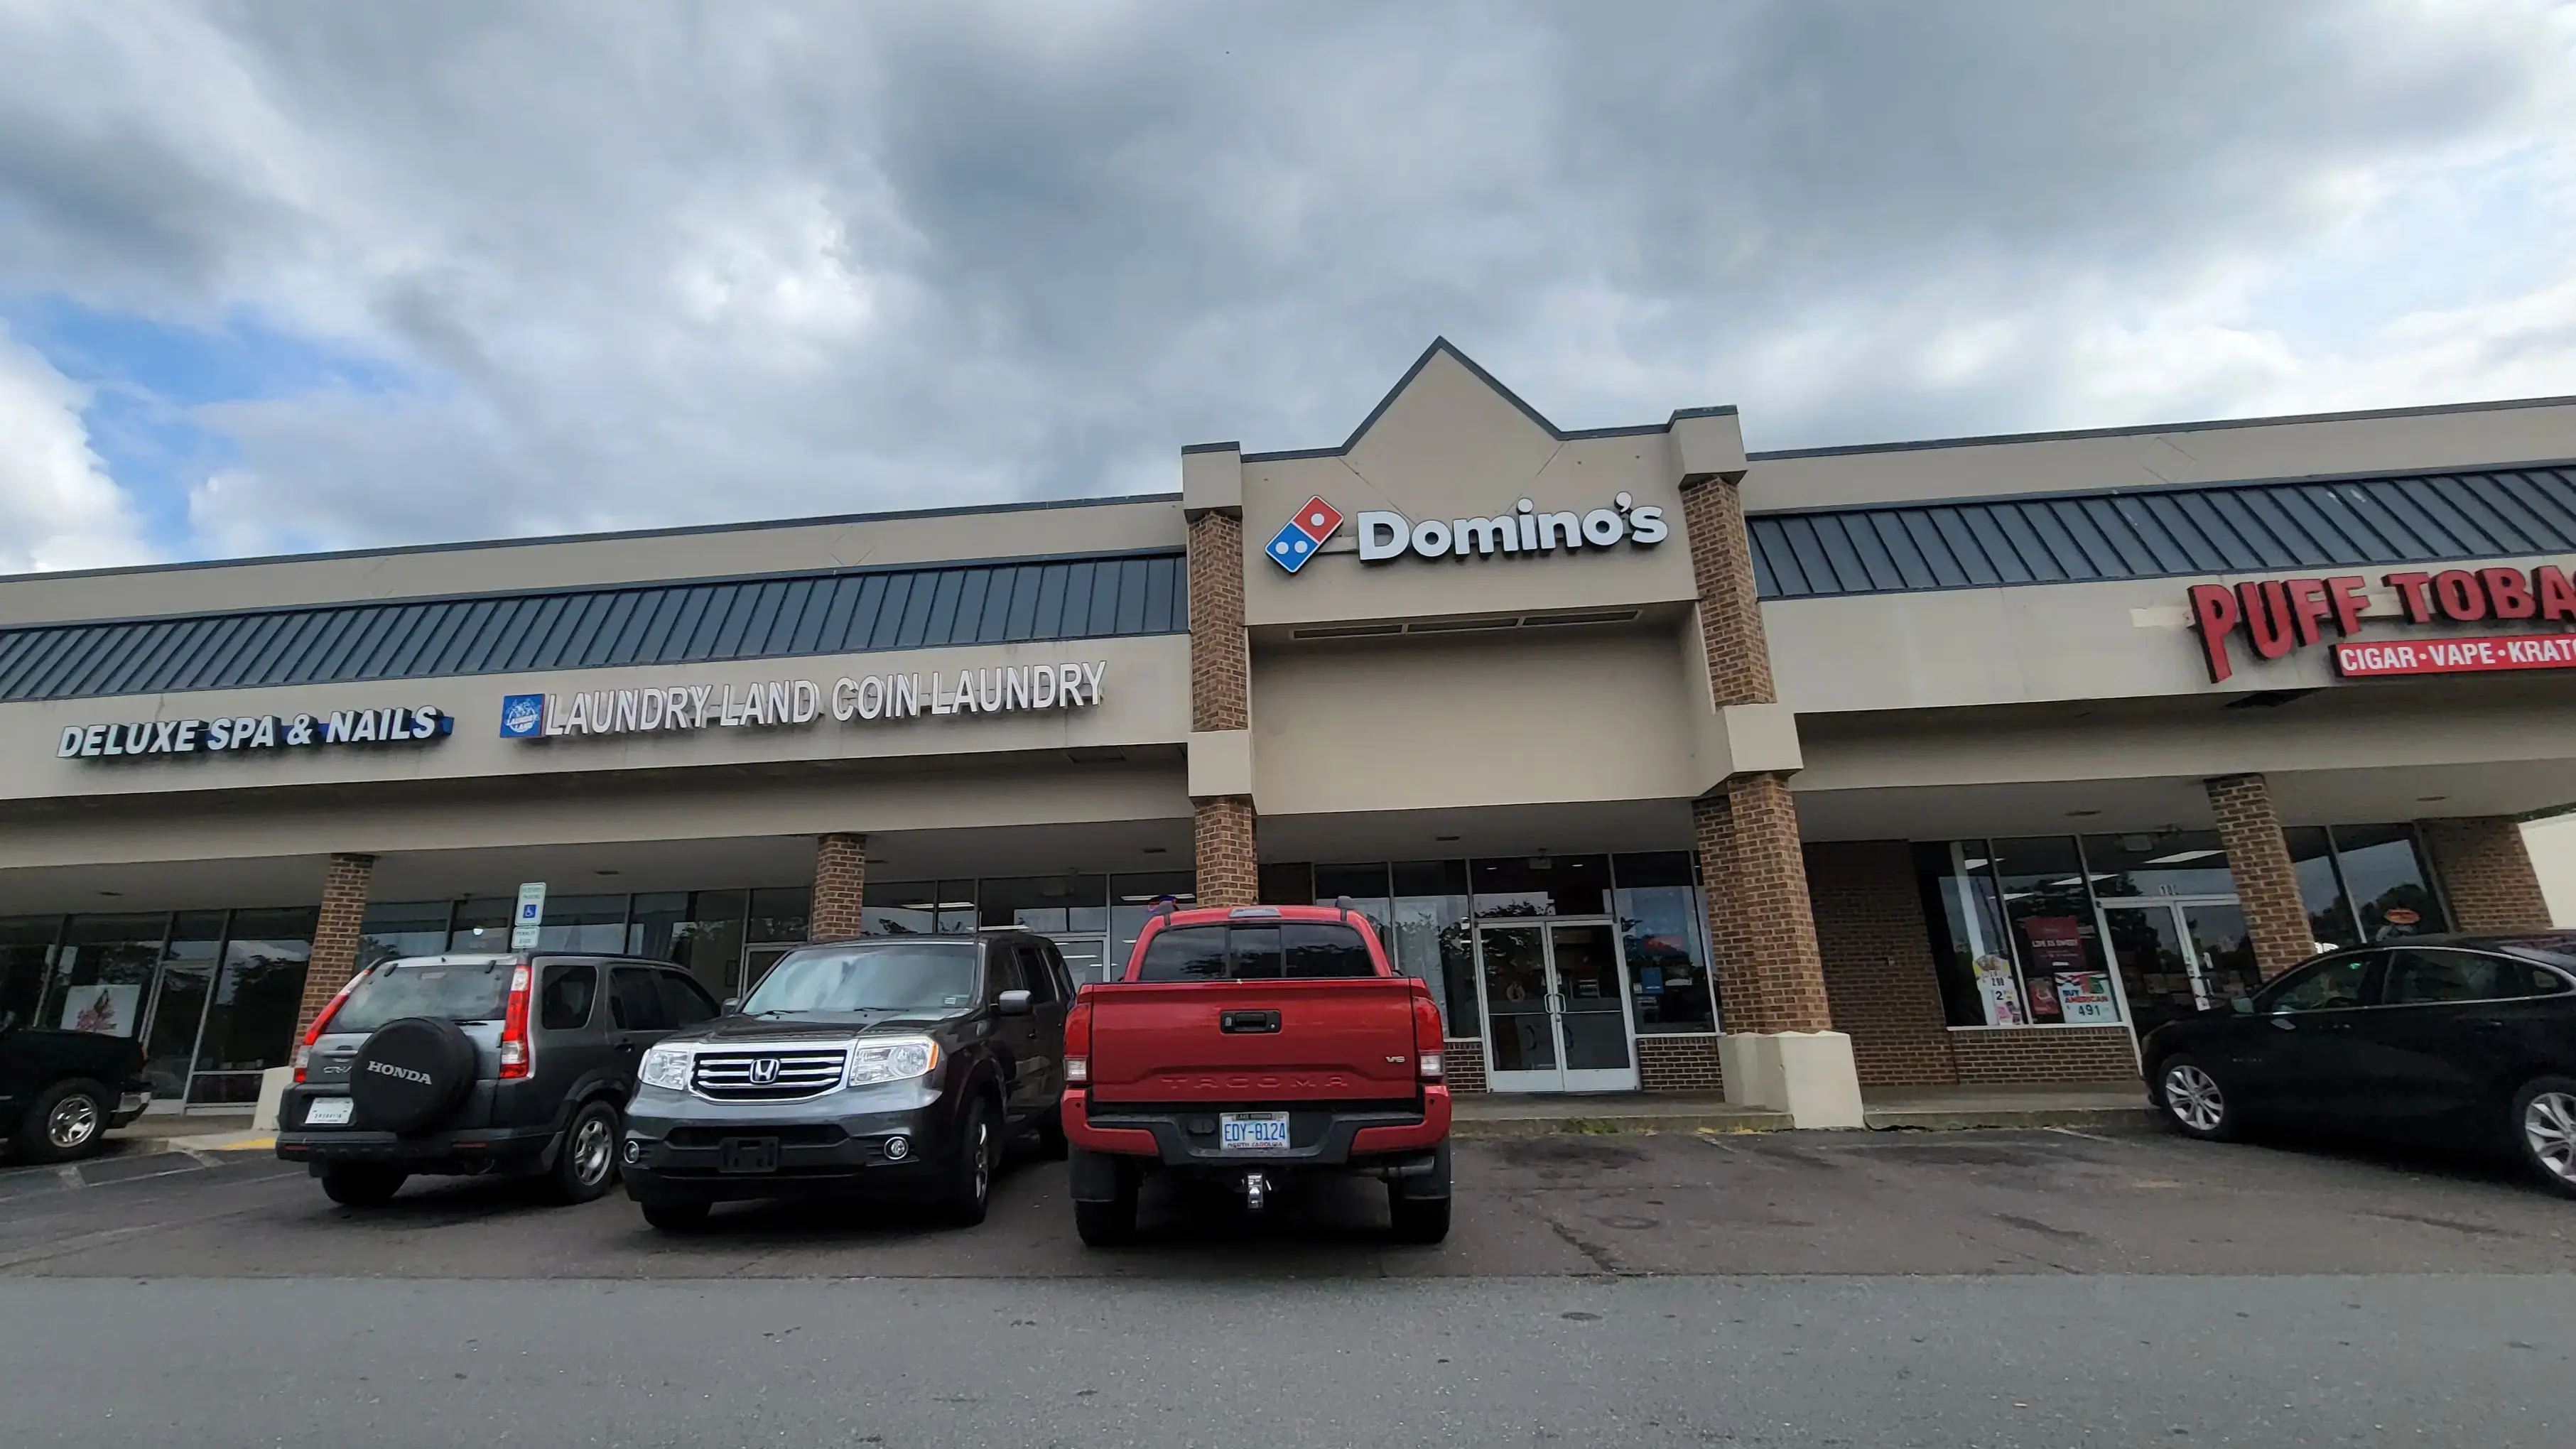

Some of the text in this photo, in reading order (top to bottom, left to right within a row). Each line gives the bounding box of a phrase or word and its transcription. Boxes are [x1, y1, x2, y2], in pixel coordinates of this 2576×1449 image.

[1357, 492, 1668, 561] Domino's
[2189, 565, 2576, 683] PUFF TOBA
[2340, 638, 2576, 671] CIGAR VAPE KRAT
[546, 661, 1107, 737] LAUNDRY LAND COIN LAUNDRY
[57, 705, 439, 758] DELUXE SPA & NAILS
[366, 1060, 433, 1085] HONDA
[1162, 1075, 1349, 1090] TACOMA
[1224, 1122, 1286, 1142] EDY-8124
